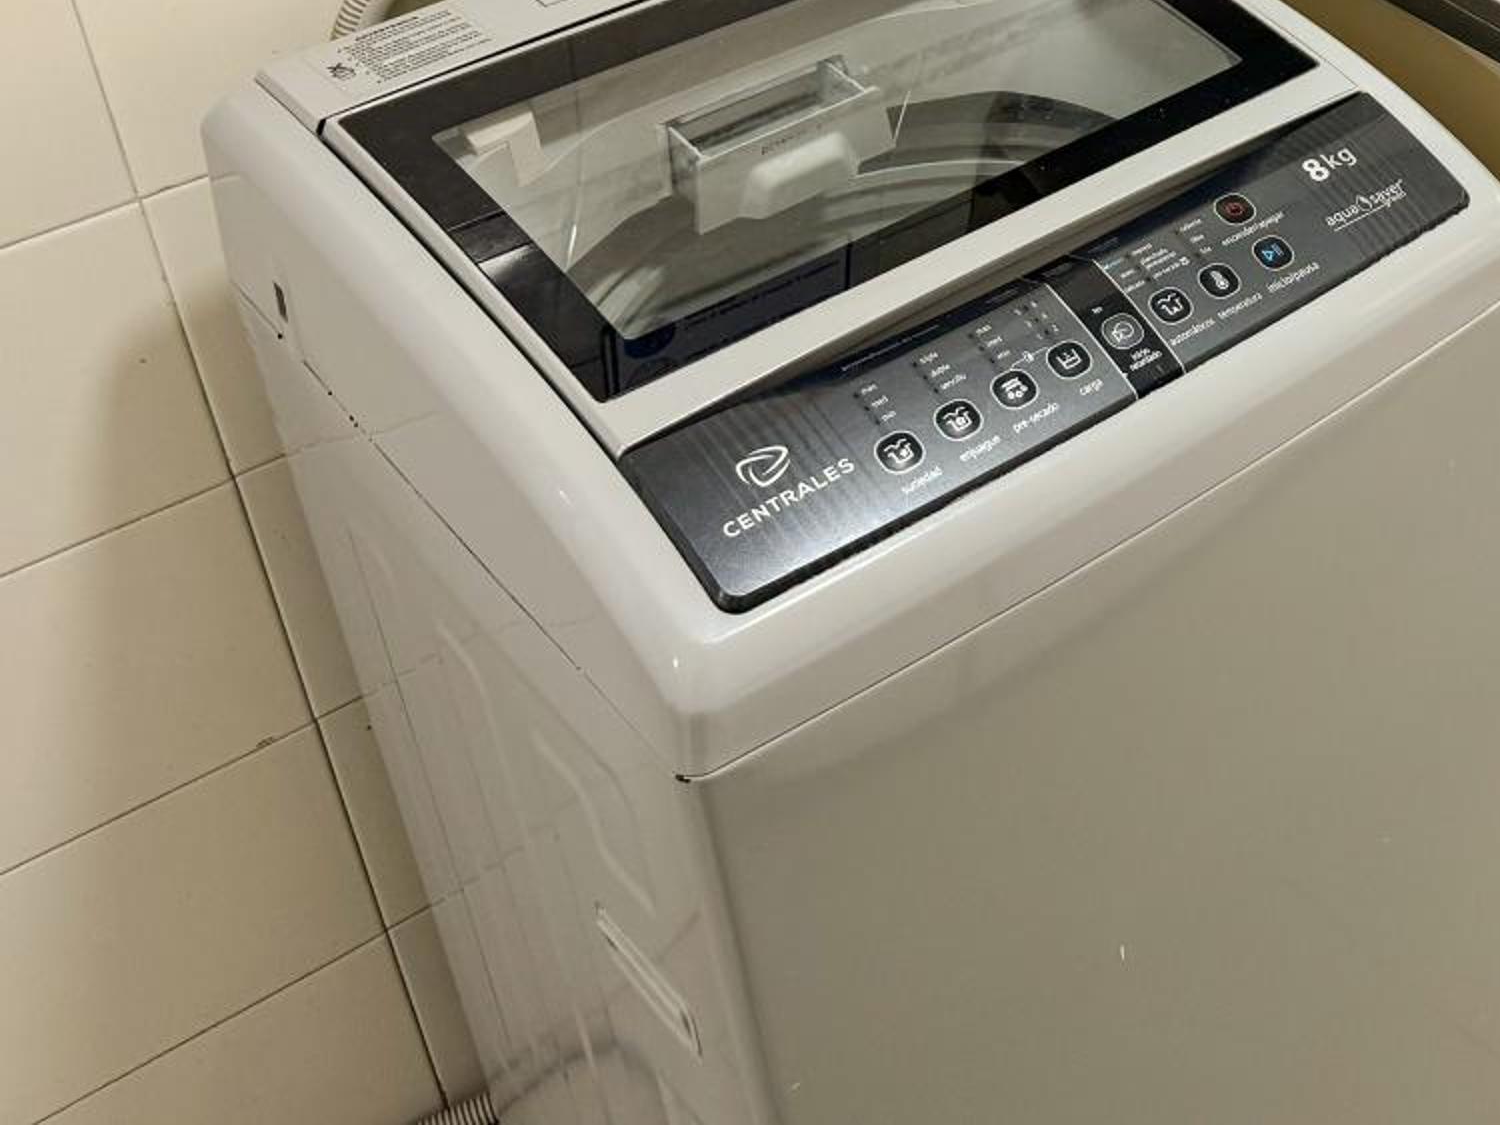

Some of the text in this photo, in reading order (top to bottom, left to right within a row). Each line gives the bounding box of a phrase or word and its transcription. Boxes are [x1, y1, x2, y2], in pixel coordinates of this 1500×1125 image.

[1325, 205, 1359, 227] aqua
[1079, 378, 1105, 397] carga
[722, 458, 855, 538] CENTRALES
